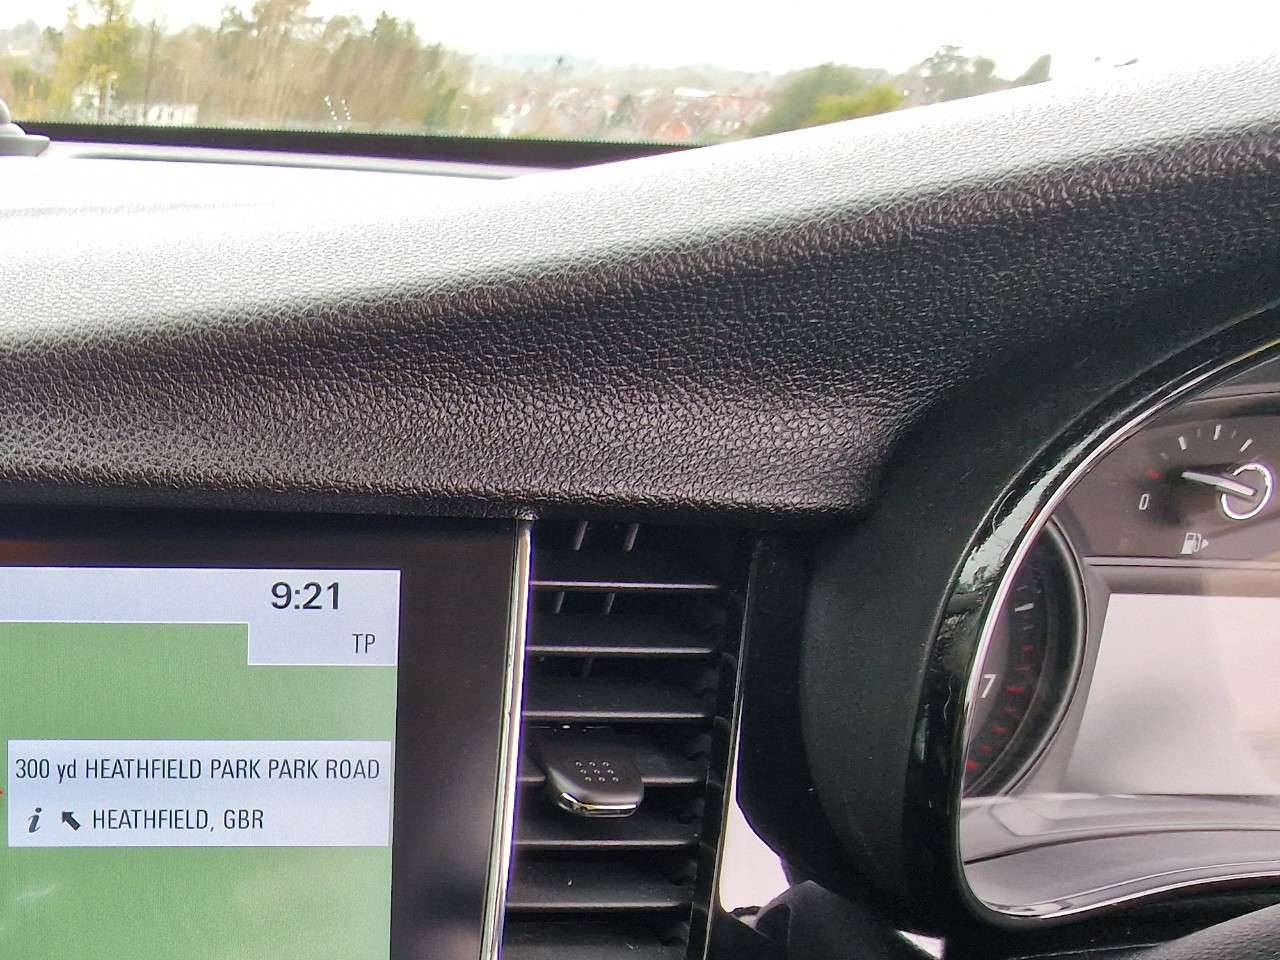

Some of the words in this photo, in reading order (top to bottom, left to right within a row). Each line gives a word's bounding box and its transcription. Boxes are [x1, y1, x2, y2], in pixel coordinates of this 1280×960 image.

[1138, 493, 1151, 511] 0
[271, 582, 341, 610] 9:21
[352, 633, 376, 653] TP
[980, 673, 997, 699] 7
[15, 759, 50, 779] 300
[57, 759, 77, 784] yd
[85, 758, 202, 780] HEATHFIELD
[210, 758, 261, 779] PARK
[268, 758, 319, 779] PARK
[325, 758, 381, 780] ROAD
[92, 809, 215, 832] HEATHFIELD,
[223, 809, 264, 830] GBR
